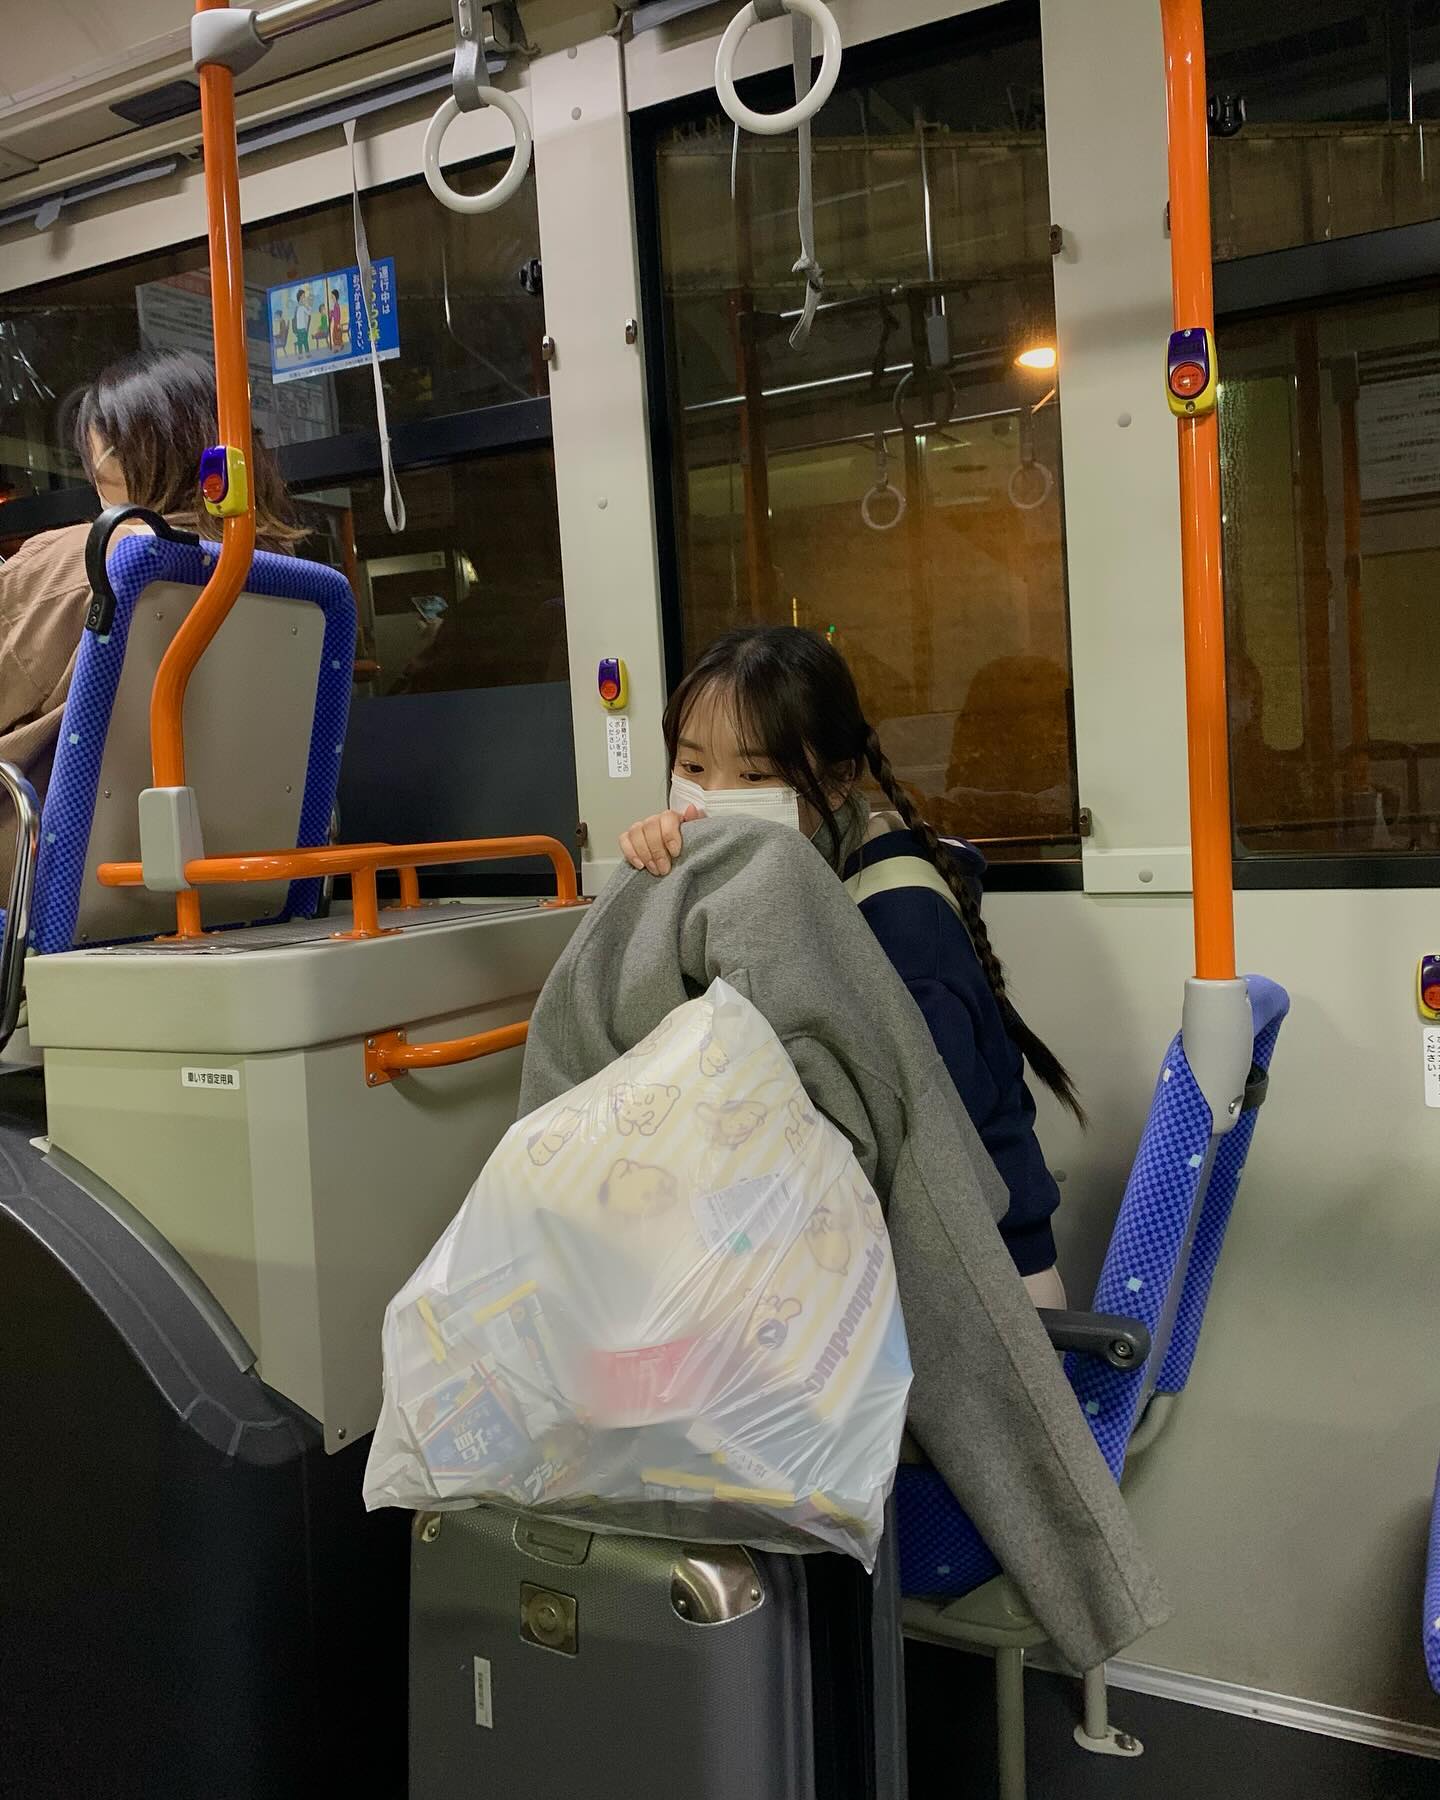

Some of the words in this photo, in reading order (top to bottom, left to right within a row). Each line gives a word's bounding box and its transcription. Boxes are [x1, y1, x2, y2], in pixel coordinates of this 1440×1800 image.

[187, 1072, 234, 1086] 車いす固定用具
